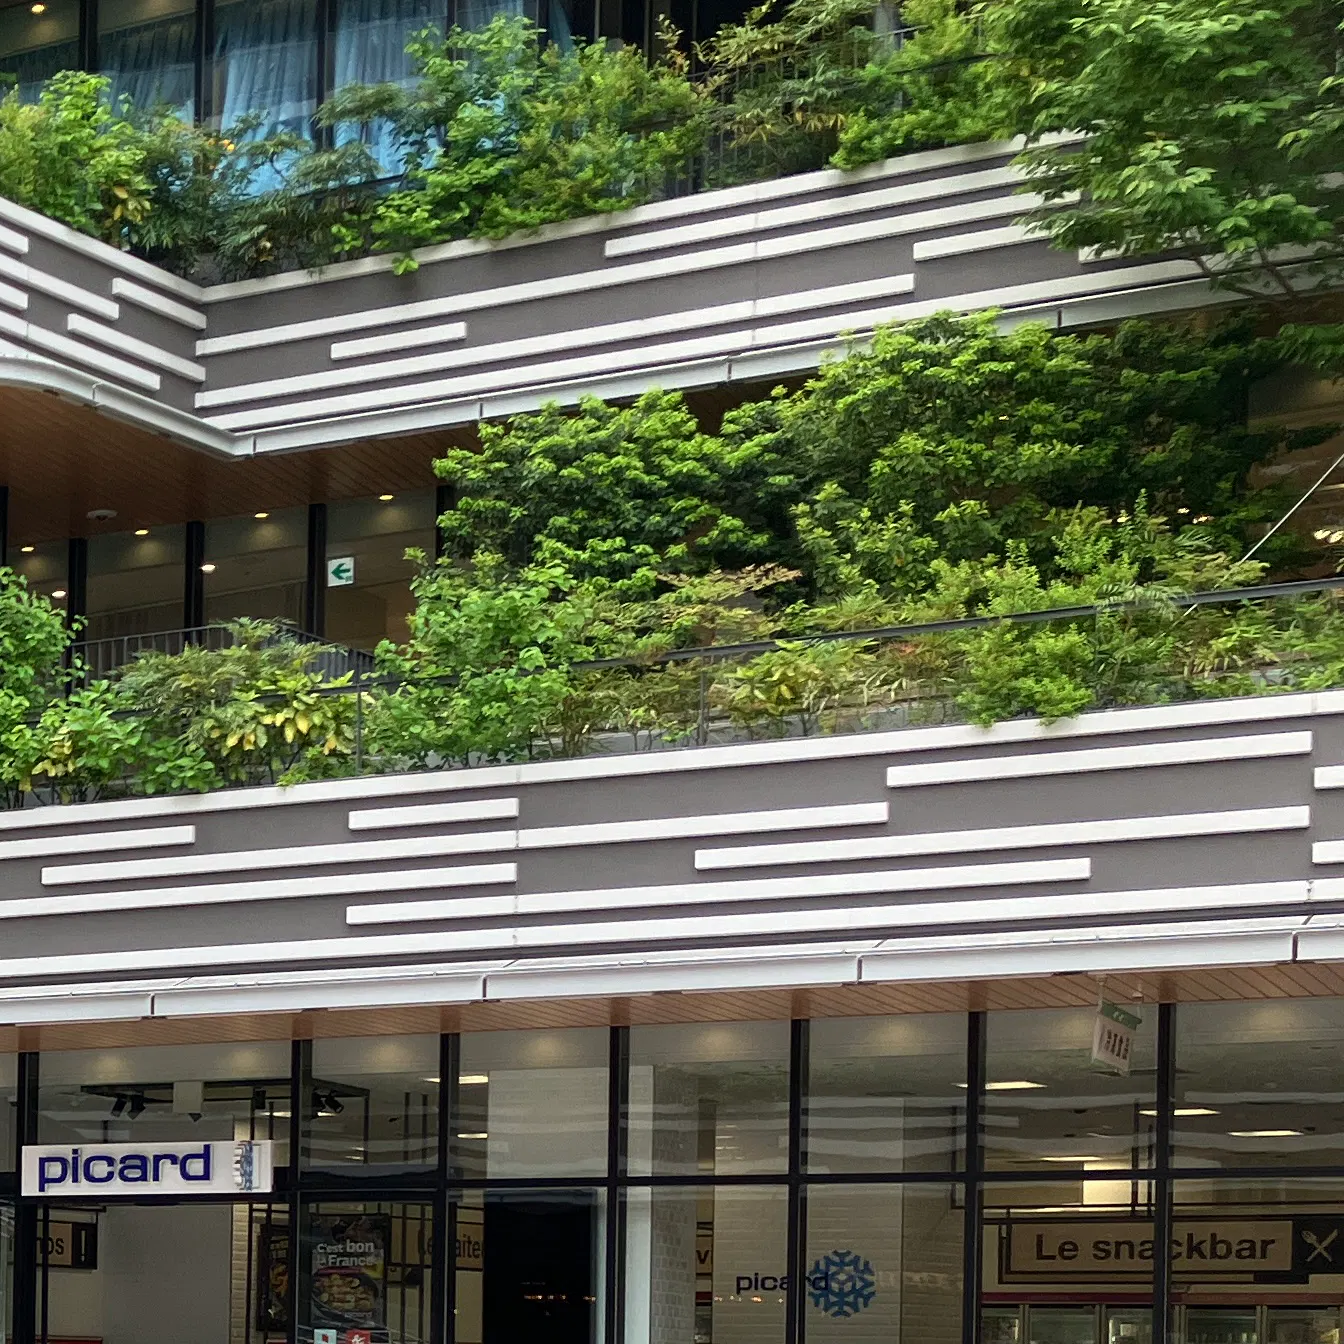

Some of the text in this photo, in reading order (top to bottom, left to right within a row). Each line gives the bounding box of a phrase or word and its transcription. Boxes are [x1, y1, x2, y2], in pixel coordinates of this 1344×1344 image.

[37, 1144, 212, 1193] picard
[317, 1238, 375, 1253] C'est bon
[1036, 1232, 1276, 1261] Le snackbar
[328, 1254, 375, 1266] France
